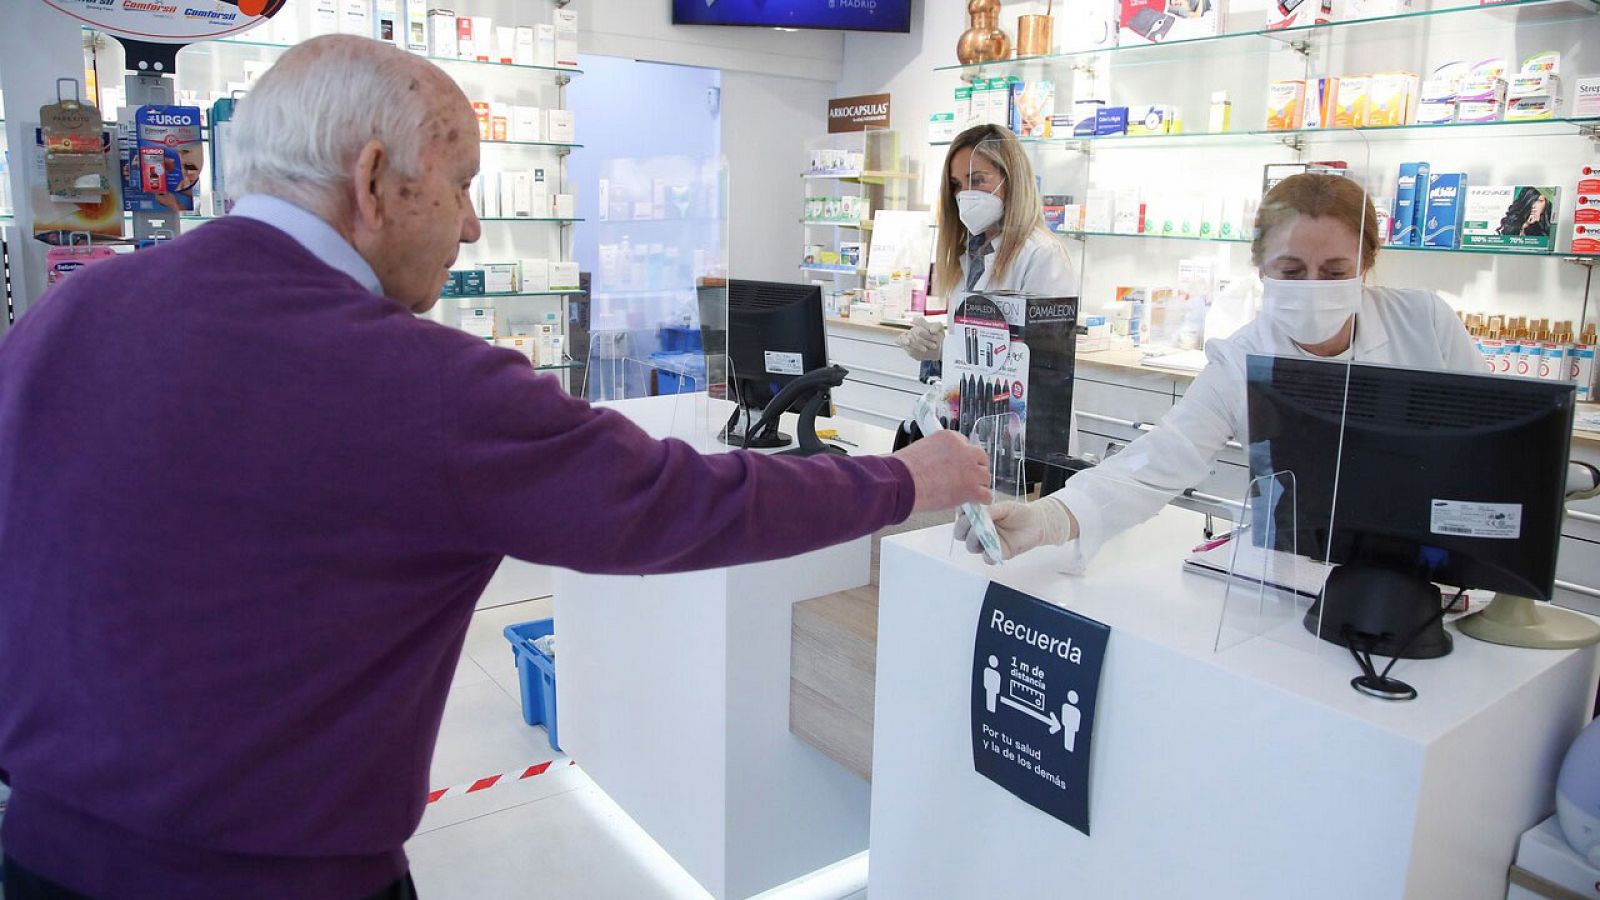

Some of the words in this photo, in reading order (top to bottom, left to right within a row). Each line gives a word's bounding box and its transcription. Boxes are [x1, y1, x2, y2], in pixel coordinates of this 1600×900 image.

[123, 1, 177, 13] Comforsil
[840, 0, 876, 8] MADRID
[184, 8, 236, 21] Comforsil
[830, 103, 887, 117] ARKOCAPSULAS
[155, 115, 191, 125] URGO
[1029, 304, 1075, 318] CAMALEON
[990, 609, 1082, 665] Recuerda
[1011, 656, 1017, 667] 1
[1019, 662, 1029, 673] m
[1032, 666, 1044, 679] de
[1010, 668, 1046, 690] distancia
[983, 724, 999, 738] Por
[1001, 733, 1012, 746] tu
[1015, 740, 1041, 760] salud
[983, 739, 989, 749] y
[991, 741, 1000, 753] la
[1002, 748, 1015, 761] de
[1017, 754, 1032, 770] los
[1034, 765, 1066, 790] demás
